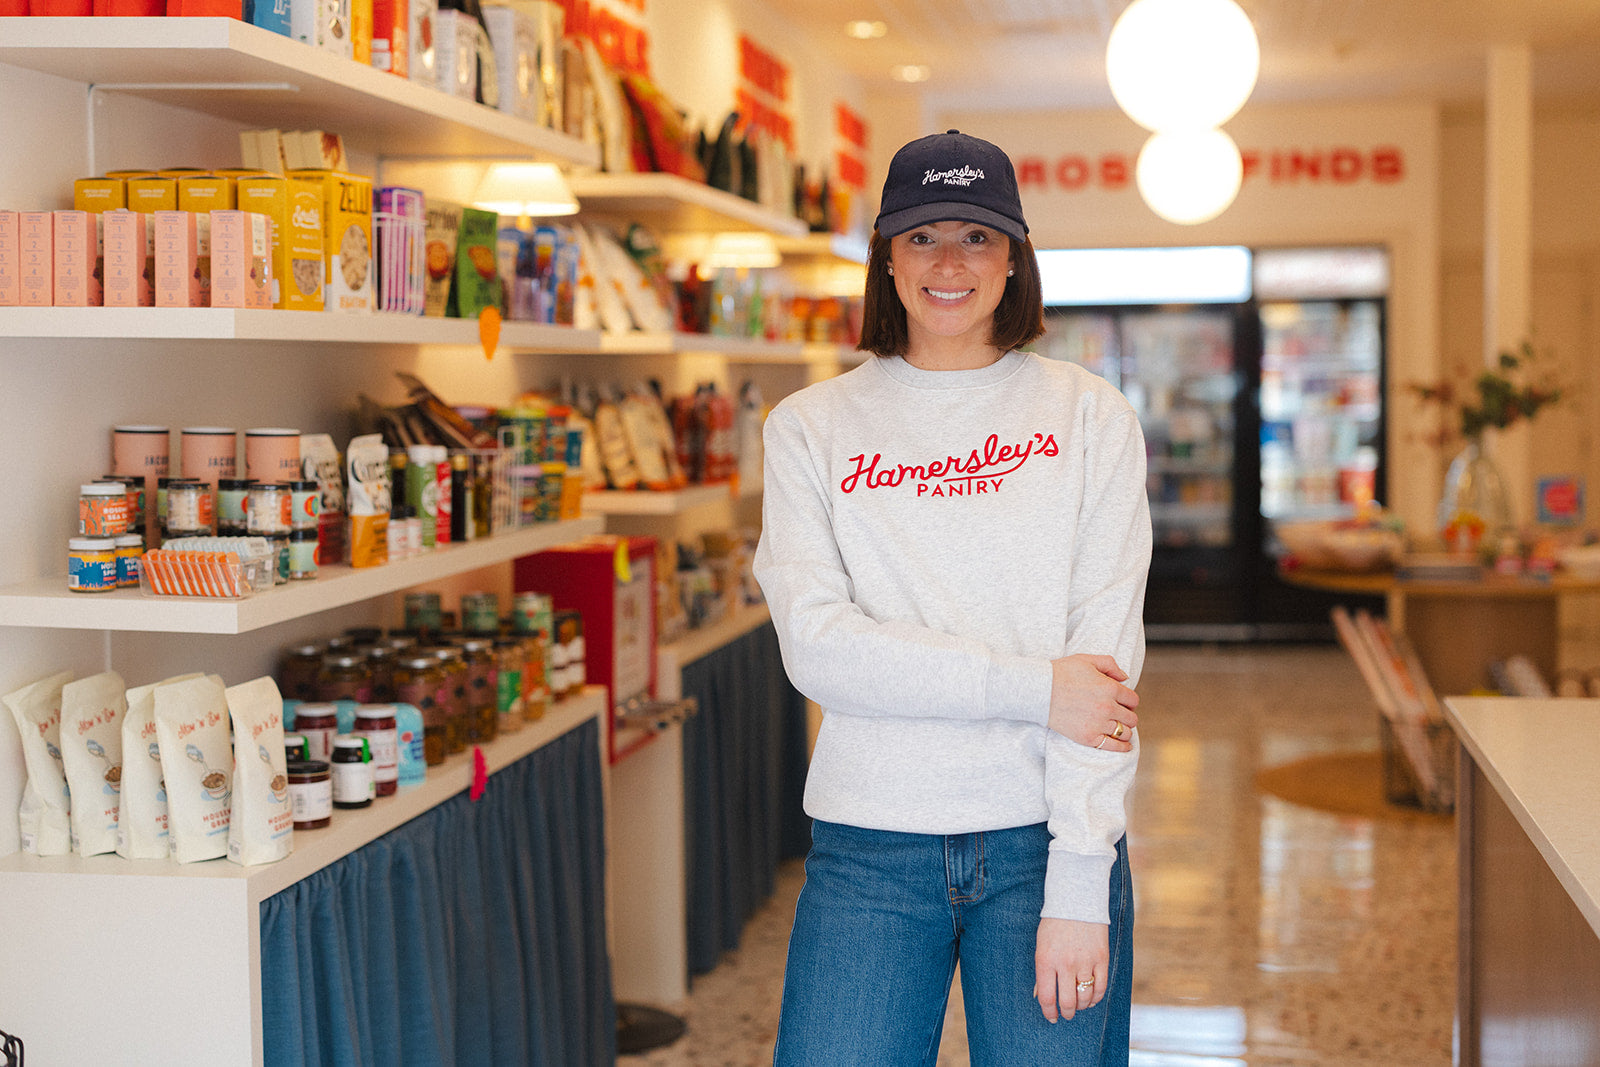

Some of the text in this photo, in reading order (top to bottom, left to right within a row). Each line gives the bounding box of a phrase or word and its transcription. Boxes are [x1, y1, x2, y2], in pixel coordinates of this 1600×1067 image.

[922, 164, 985, 185] Hamersley's
[943, 178, 971, 187] PANTRY
[840, 432, 1060, 494] Hamersley's
[917, 477, 1004, 497] PANTRY
